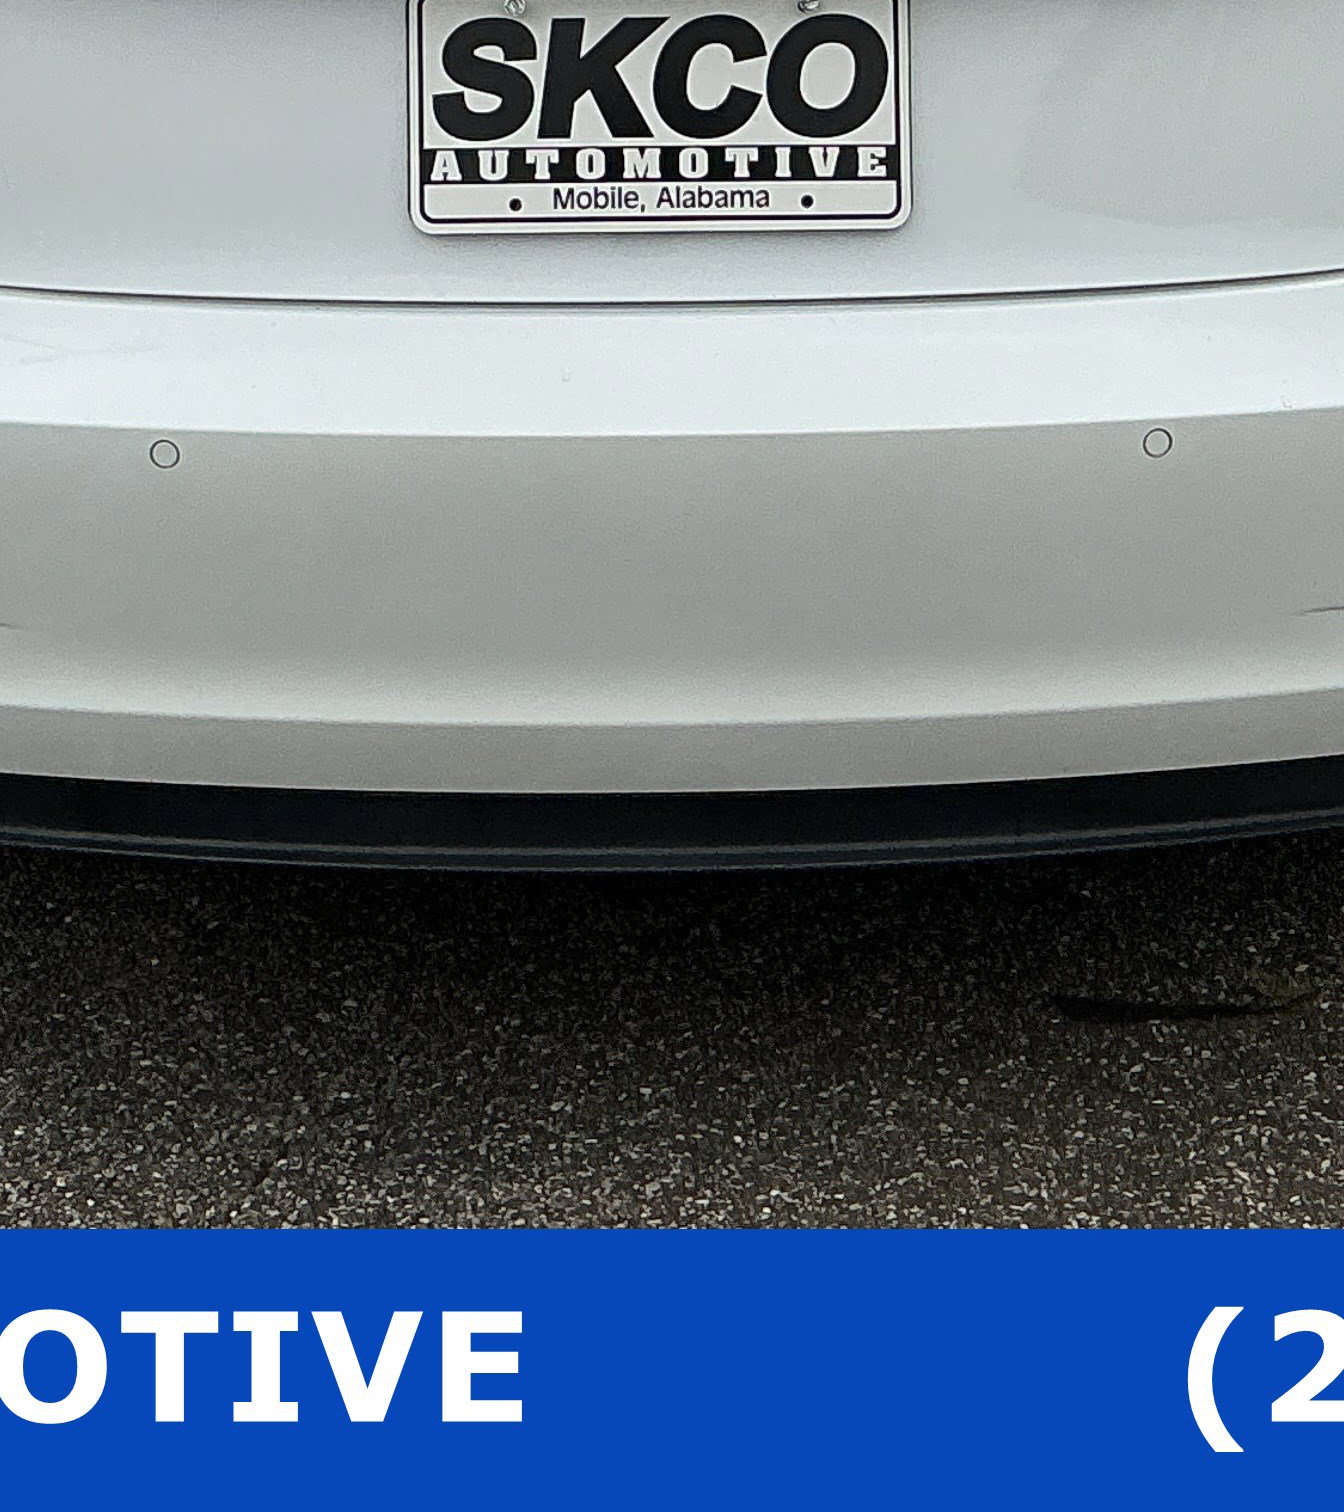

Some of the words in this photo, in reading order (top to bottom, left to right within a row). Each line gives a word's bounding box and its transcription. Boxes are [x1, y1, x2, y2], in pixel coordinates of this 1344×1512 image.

[432, 13, 889, 142] SKCO
[431, 147, 888, 181] AUTOMOTIVE
[553, 186, 646, 213] Mobile,
[656, 185, 770, 210] Alabama
